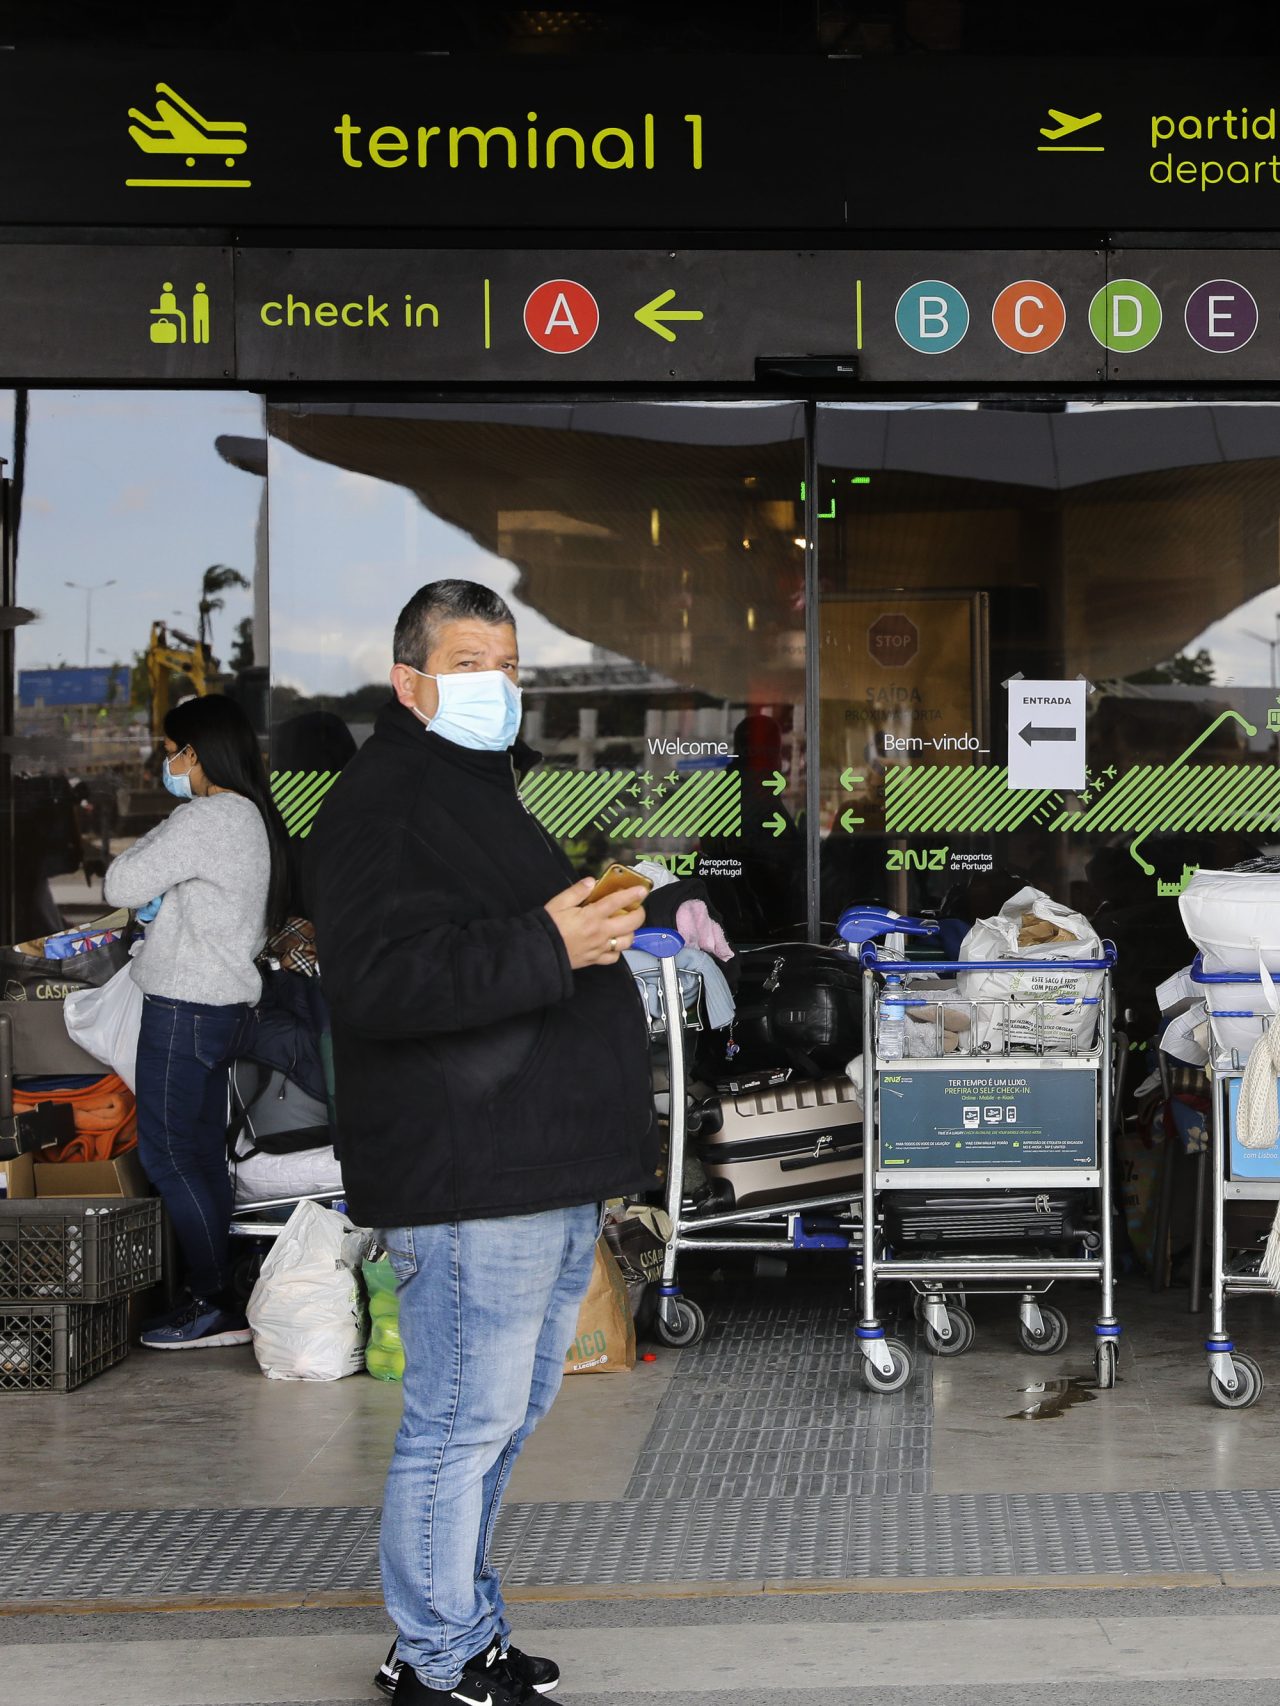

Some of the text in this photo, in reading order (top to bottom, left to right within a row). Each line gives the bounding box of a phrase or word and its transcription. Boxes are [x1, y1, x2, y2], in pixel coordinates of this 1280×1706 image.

[334, 112, 702, 169] terminal 1
[260, 294, 579, 335] check in A
[918, 295, 949, 338] B
[1014, 295, 1044, 338] C
[1113, 295, 1143, 337] D
[1208, 295, 1235, 337] E
[875, 635, 912, 648] STOP
[1022, 696, 1073, 705] ENTRADA
[950, 852, 993, 863] Aeroportos
[698, 867, 742, 878] de Portugal
[950, 862, 993, 873] de Portugal
[36, 984, 69, 999] CASA
[948, 1079, 962, 1087] TER
[962, 1079, 987, 1087] TEMPO
[944, 1087, 972, 1095] PREFIRA
[566, 1329, 607, 1361] ICO
